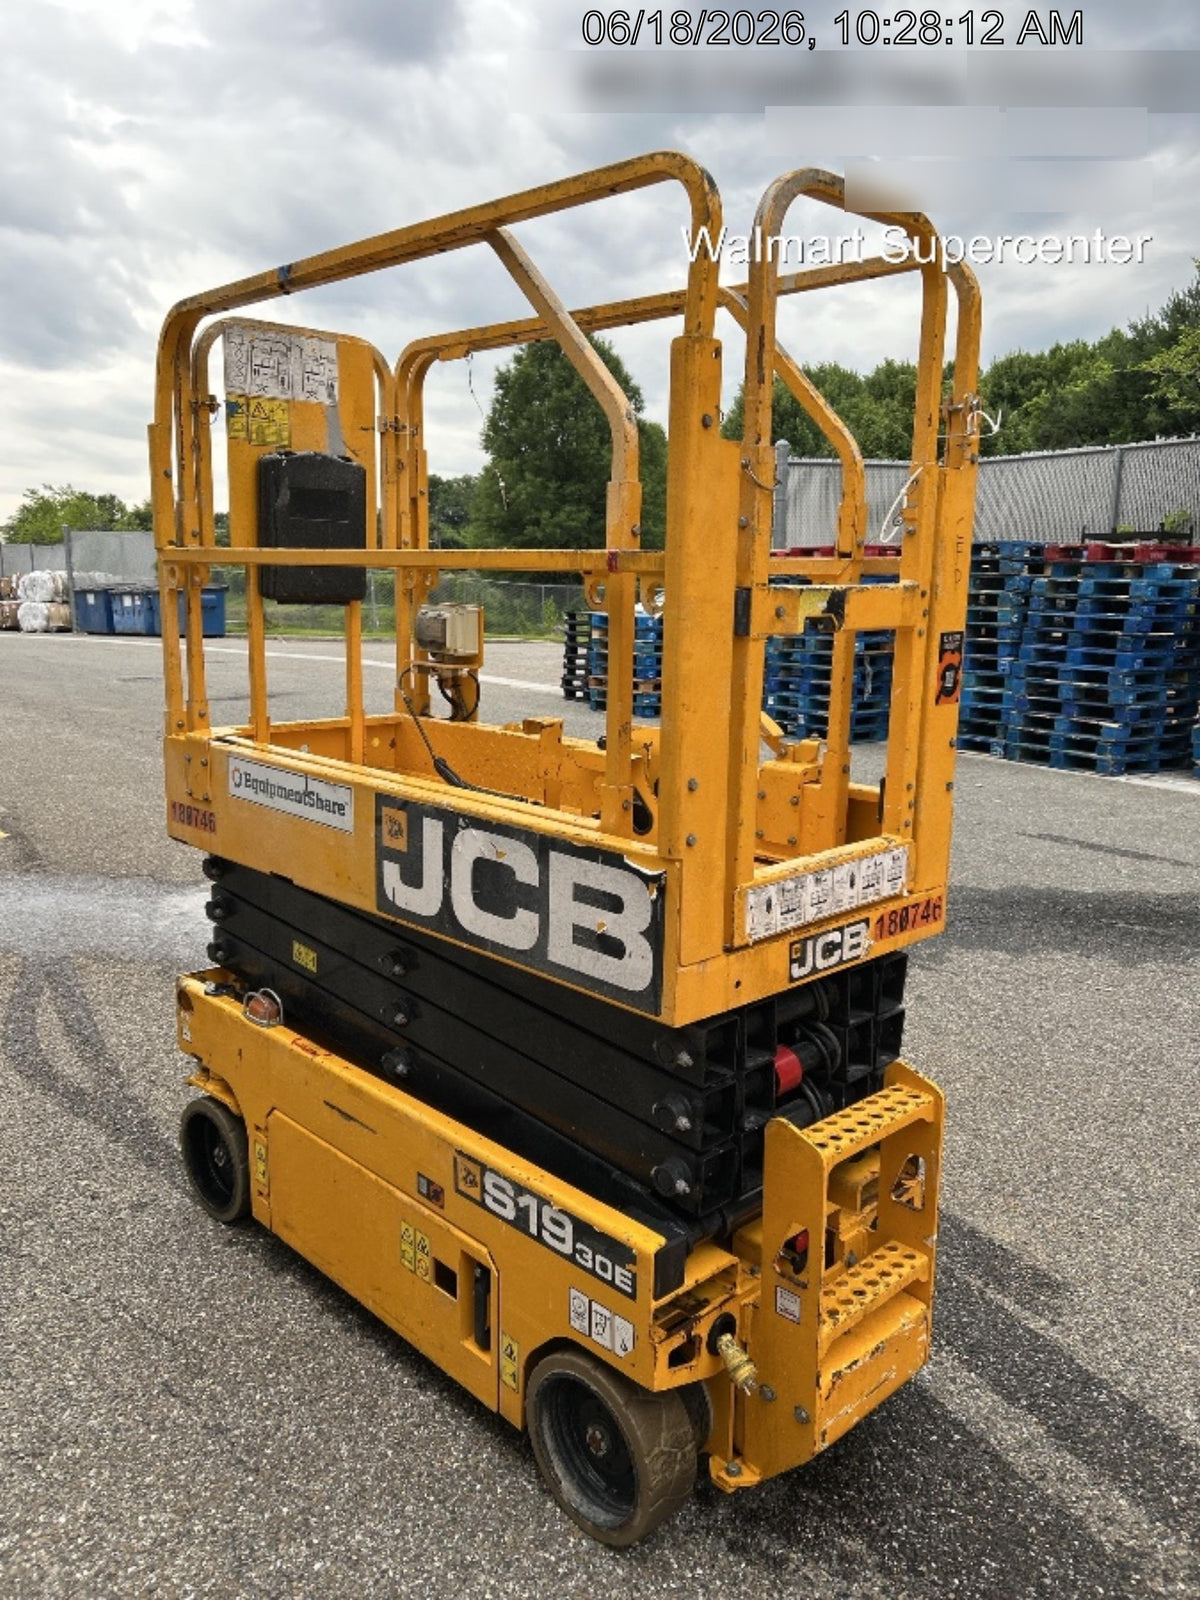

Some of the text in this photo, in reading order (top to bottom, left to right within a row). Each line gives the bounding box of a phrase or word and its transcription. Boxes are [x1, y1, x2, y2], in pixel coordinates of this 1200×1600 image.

[171, 800, 216, 833] 180746
[245, 771, 346, 817] EquipmentShare
[383, 815, 654, 992] JCB
[876, 896, 941, 940] 180746
[790, 921, 868, 979] JCB
[483, 1170, 633, 1294] S19 30E
